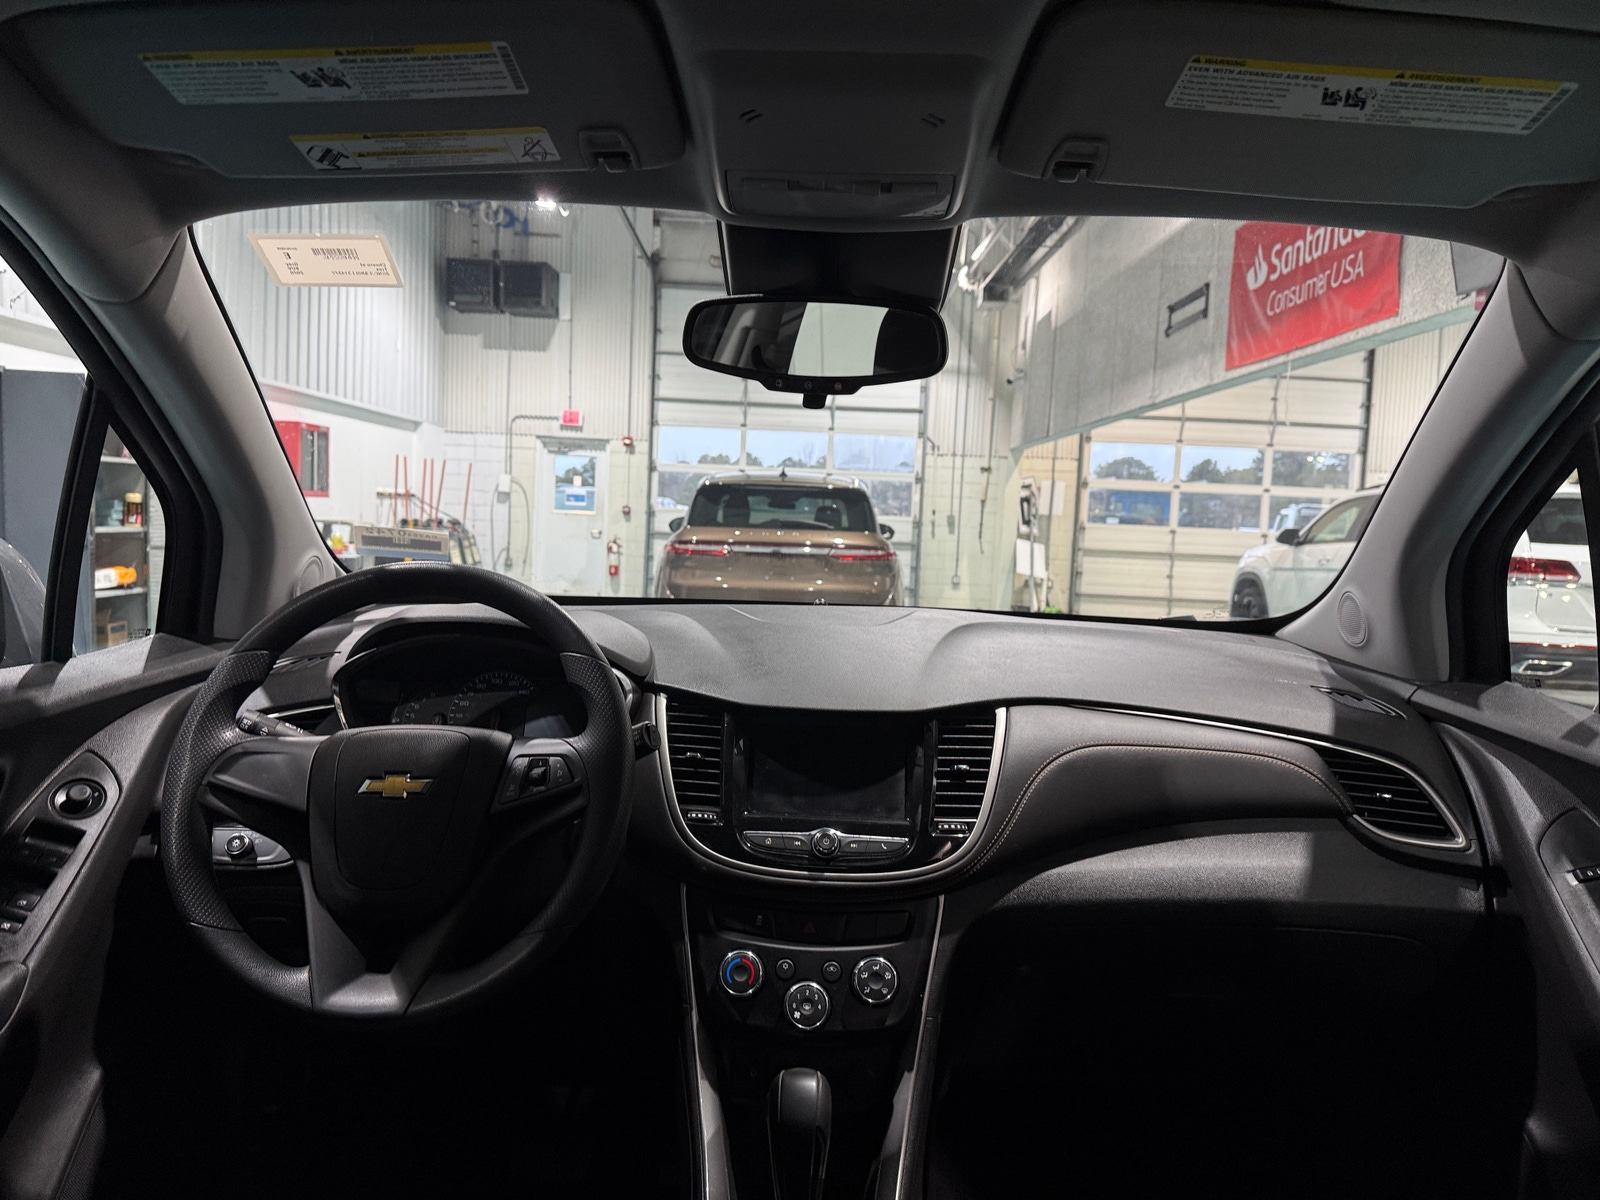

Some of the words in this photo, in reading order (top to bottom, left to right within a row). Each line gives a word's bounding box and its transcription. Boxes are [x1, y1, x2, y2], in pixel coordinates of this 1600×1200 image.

[1204, 57, 1246, 67] WARNING
[1187, 64, 1209, 72] EVEN
[1235, 69, 1283, 78] ADVANCED
[1302, 74, 1326, 82] BAGS
[1266, 269, 1330, 316] Consumer
[1330, 250, 1364, 288] USA
